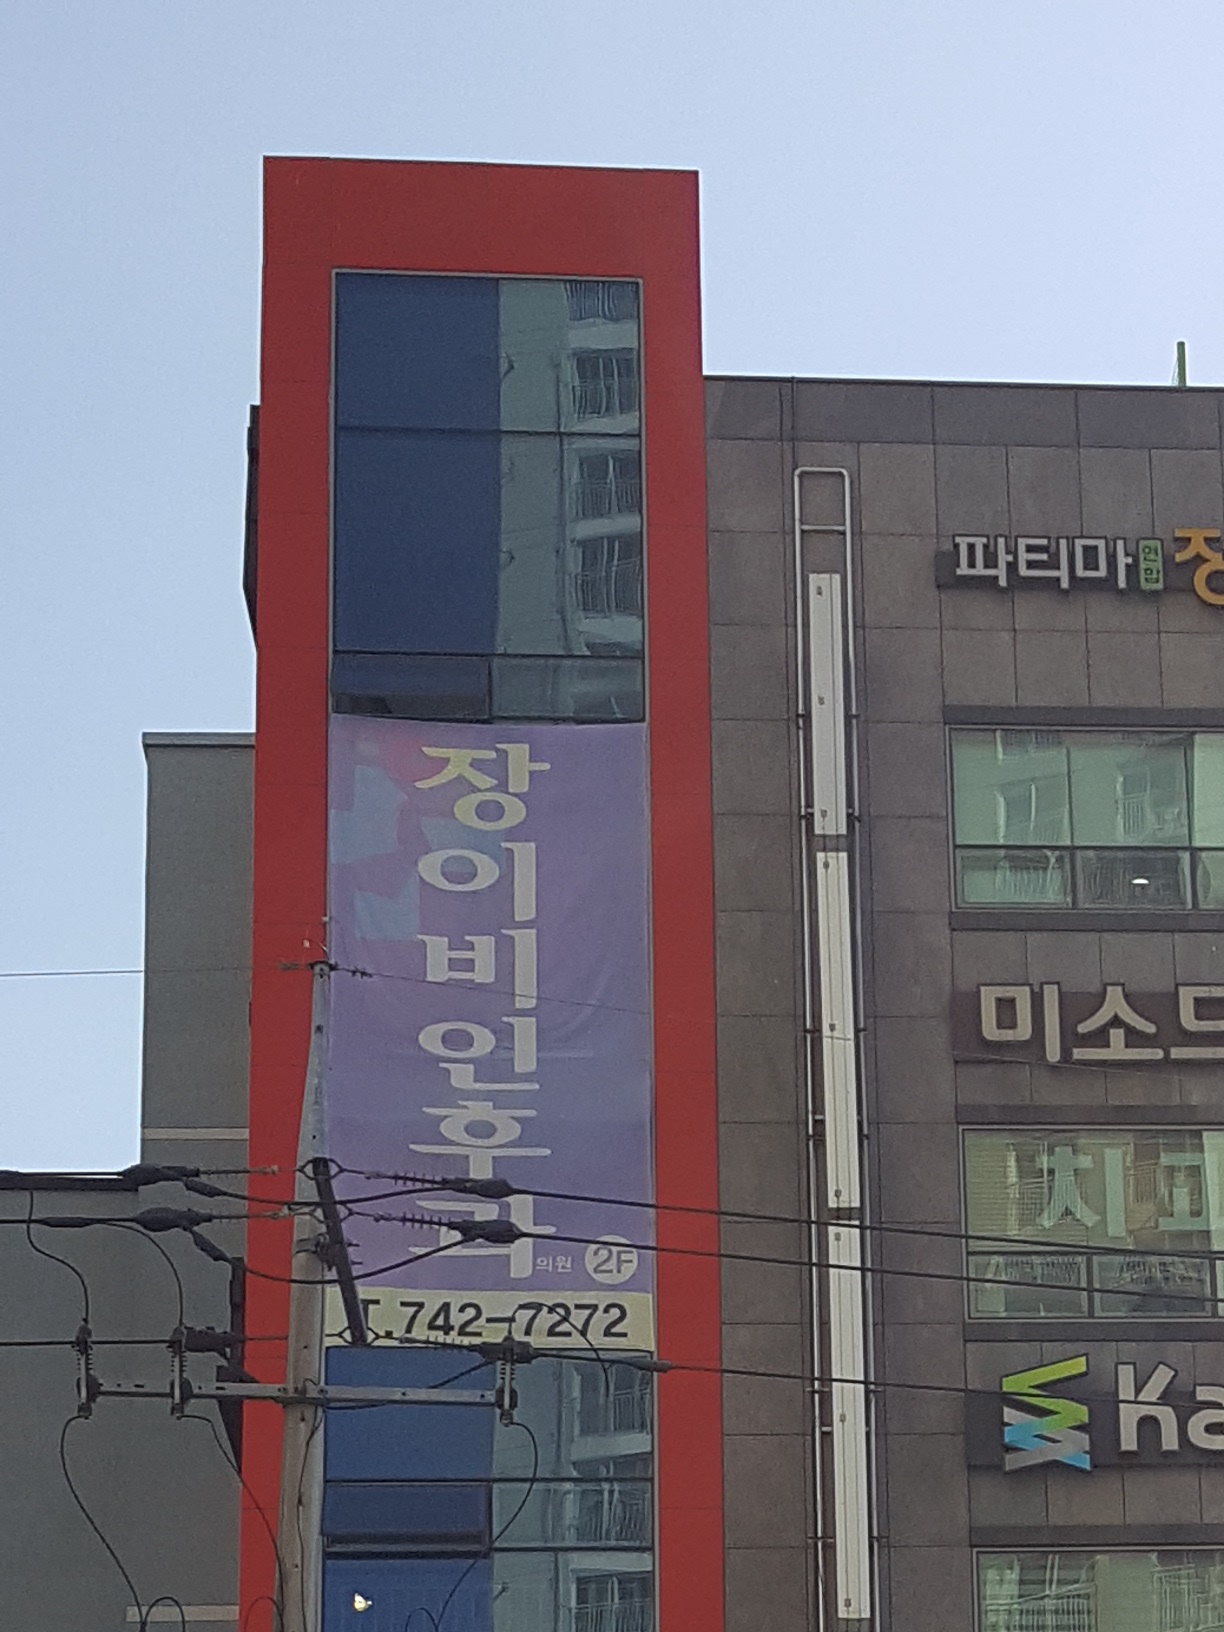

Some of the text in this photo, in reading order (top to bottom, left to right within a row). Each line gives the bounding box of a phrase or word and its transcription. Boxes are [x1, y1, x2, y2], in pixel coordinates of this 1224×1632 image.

[954, 534, 1132, 589] 파티마
[408, 743, 573, 1280] 장이비인후과 의원
[593, 1247, 634, 1274] 2F
